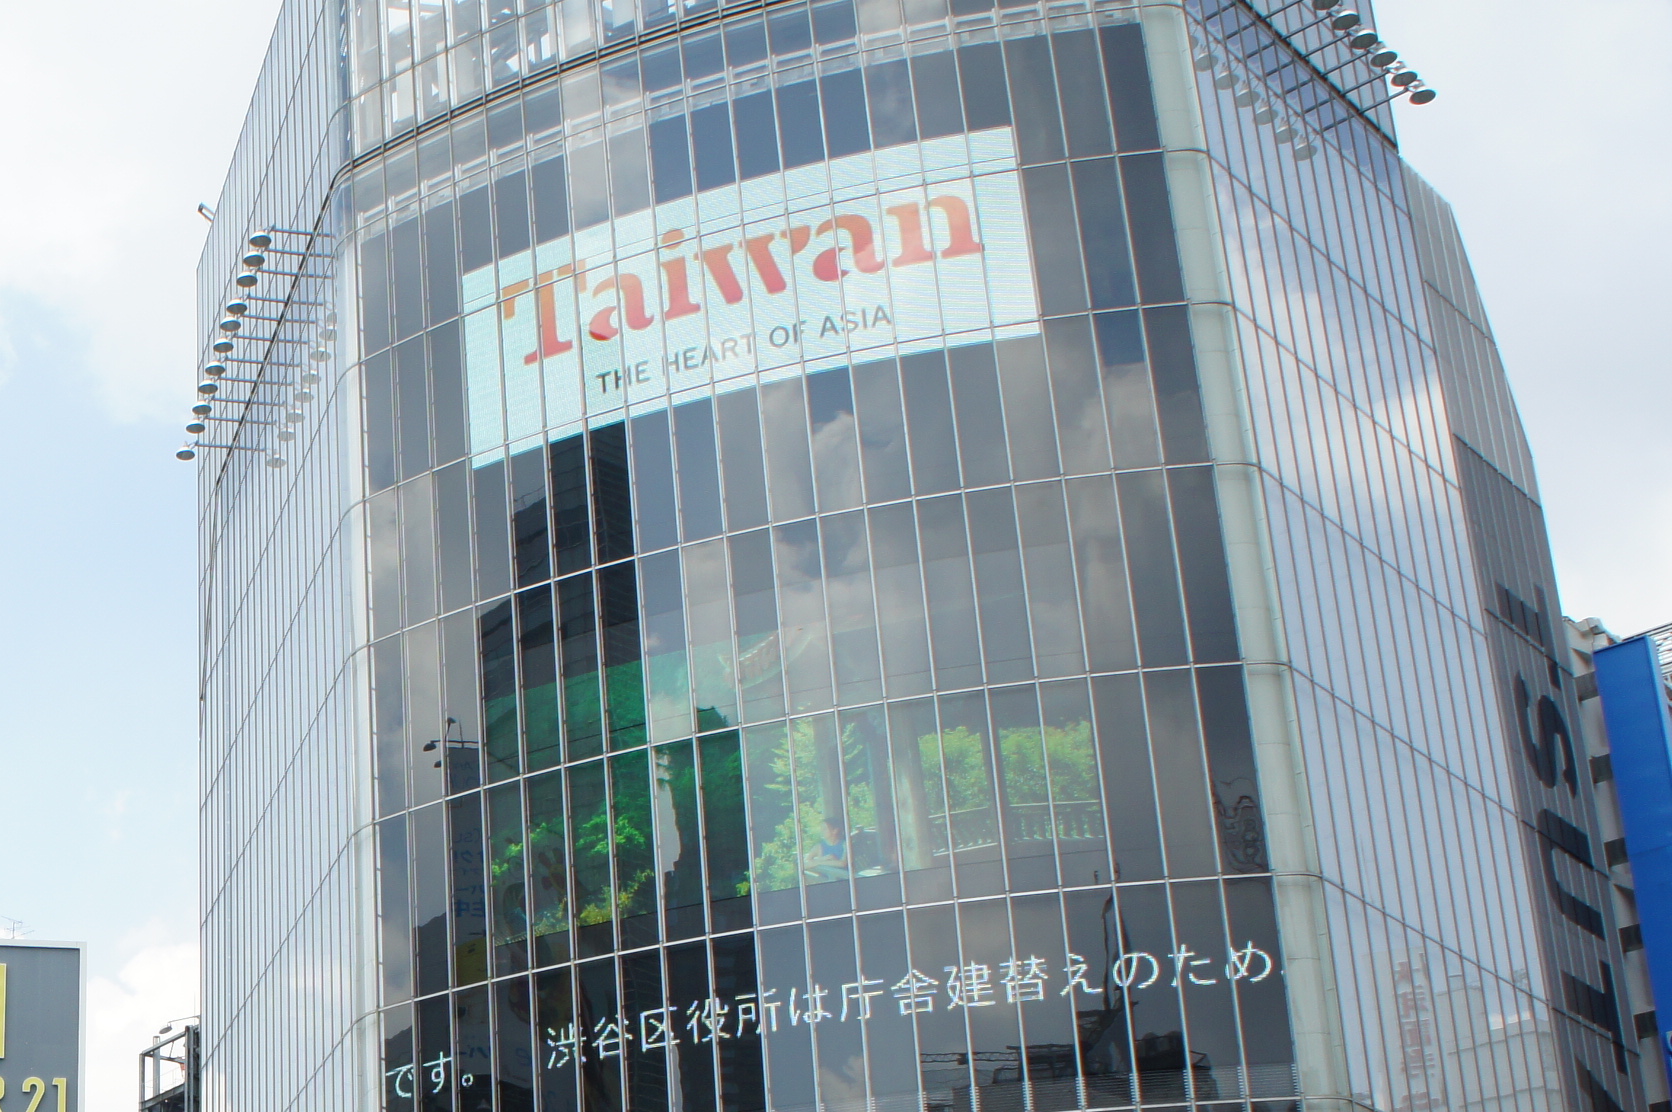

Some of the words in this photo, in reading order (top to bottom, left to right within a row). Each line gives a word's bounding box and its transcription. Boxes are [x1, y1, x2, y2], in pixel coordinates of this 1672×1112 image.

[501, 195, 983, 366] Taiwan
[596, 361, 650, 395] THE
[662, 332, 759, 377] HEART
[769, 319, 807, 349] OF
[819, 303, 892, 338] ASIA
[546, 940, 1272, 1070] 渋谷区役所は庁舎建替えのため
[385, 1050, 477, 1099] です。
